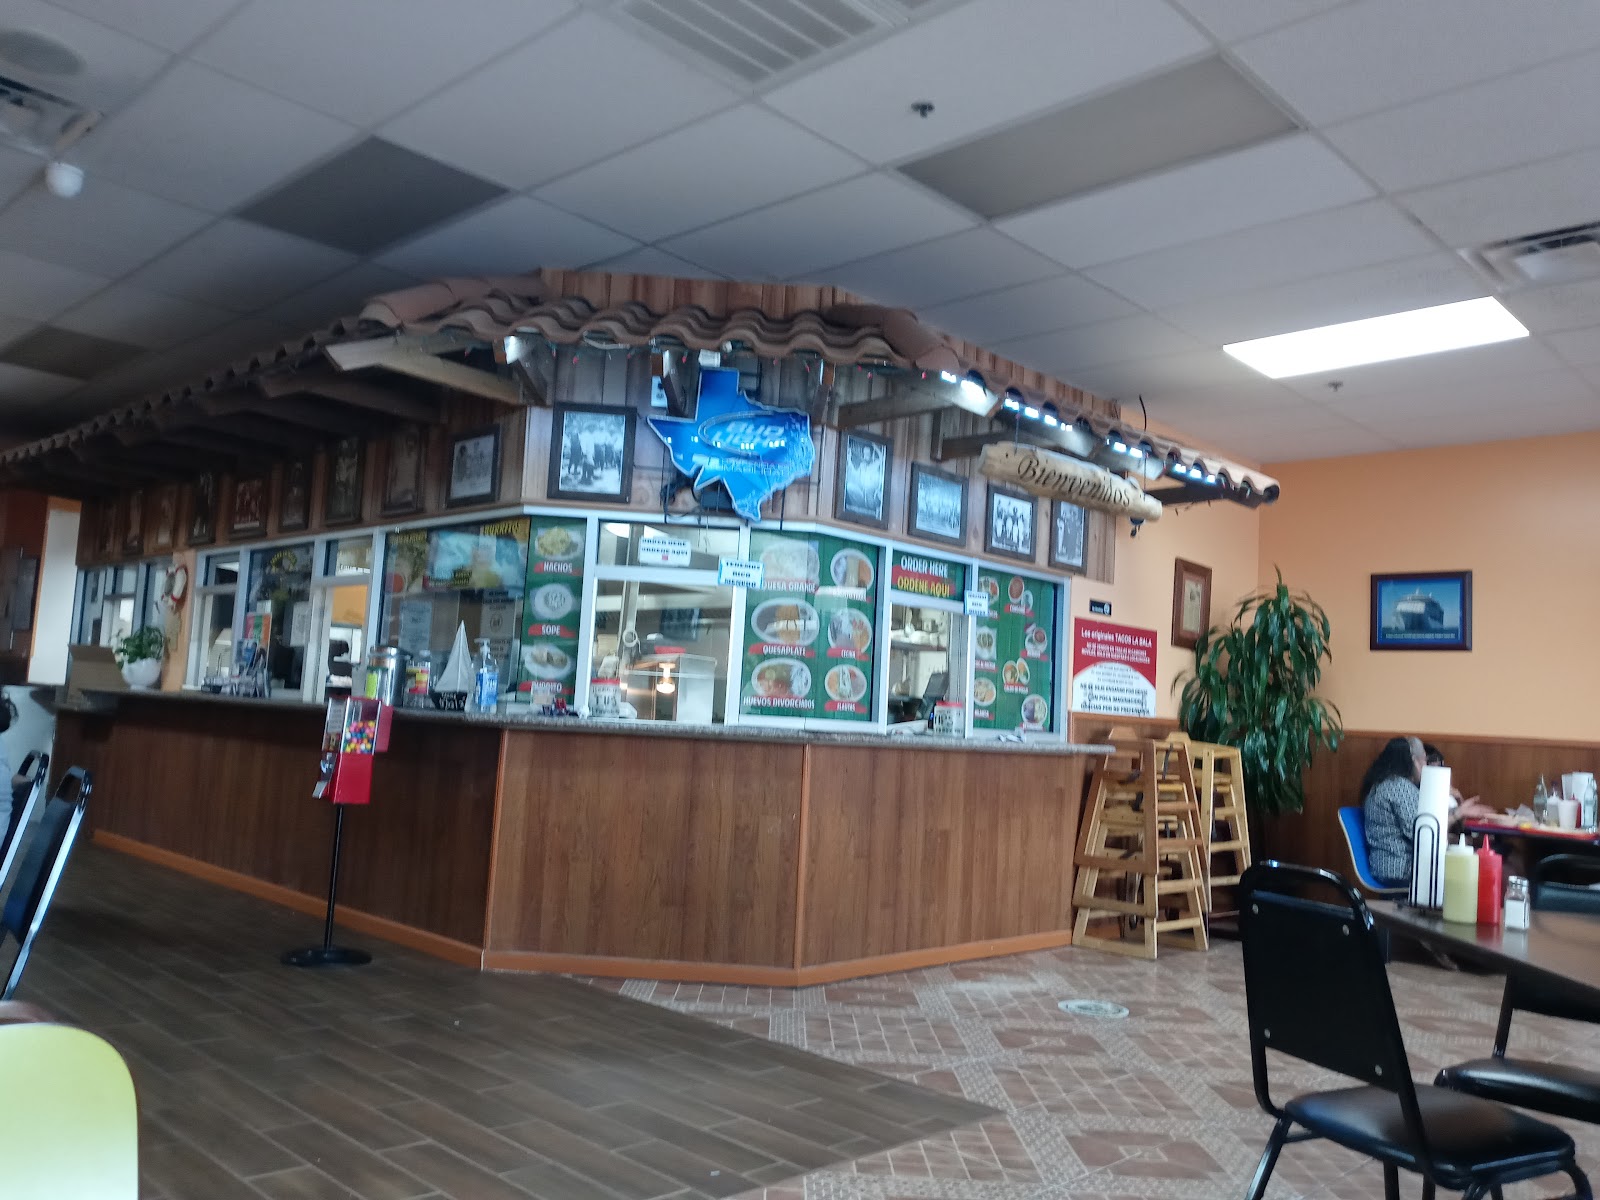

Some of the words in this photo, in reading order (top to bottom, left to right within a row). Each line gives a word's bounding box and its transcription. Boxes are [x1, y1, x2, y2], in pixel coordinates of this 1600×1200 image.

[726, 421, 784, 438] BUD
[1017, 454, 1131, 508] Bienvenidos
[543, 561, 573, 574] NACHOS
[900, 554, 928, 575] ORDER
[929, 562, 948, 579] HERE
[788, 581, 816, 593] GRANDE
[897, 575, 928, 593] ORDENE
[930, 581, 950, 598] AQUI
[541, 623, 561, 637] SOPE
[1115, 632, 1132, 646] TACOS
[1132, 636, 1139, 646] LA
[1139, 638, 1152, 649] BALA
[743, 696, 772, 708] HUEVOS
